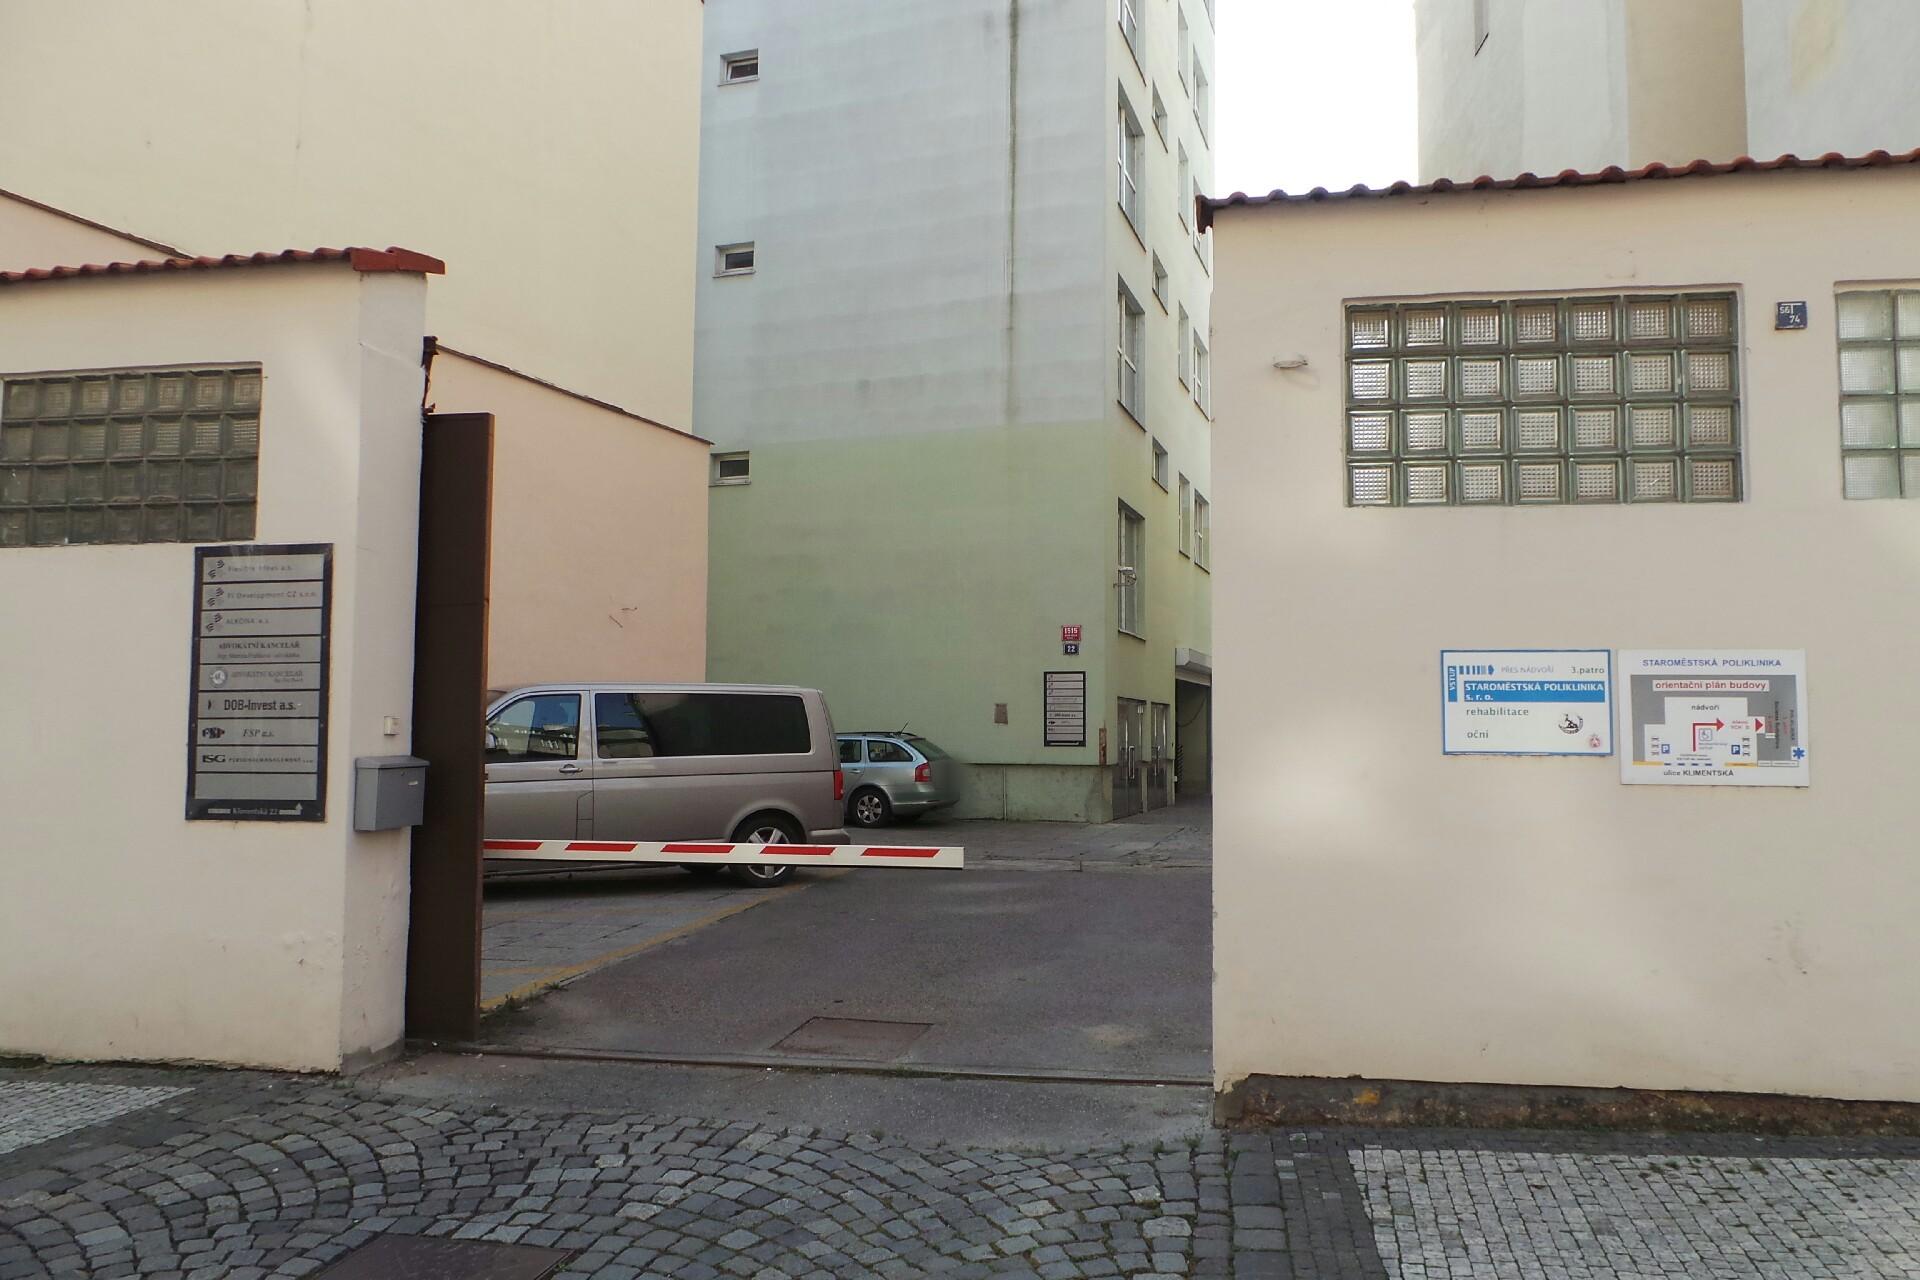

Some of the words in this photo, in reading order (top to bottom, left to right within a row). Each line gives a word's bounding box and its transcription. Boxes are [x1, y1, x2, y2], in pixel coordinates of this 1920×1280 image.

[1067, 645, 1076, 653] 22
[1642, 657, 1718, 667] STAROMĚSTSKÁ
[1722, 659, 1782, 667] POLIKLINIKA
[1571, 665, 1605, 676] 3.patro
[1465, 681, 1541, 692] STAROMĚSTSKÁ
[1544, 683, 1604, 691] POLIKLINIKA
[1655, 680, 1703, 690] orientační
[1705, 680, 1727, 691] plán
[1729, 681, 1767, 691] budovy
[224, 699, 277, 711] DOB-Invest
[1466, 707, 1529, 716] rehabilitace
[1467, 729, 1489, 739] oční
[1682, 769, 1735, 777] KLIMENTSKÁ
